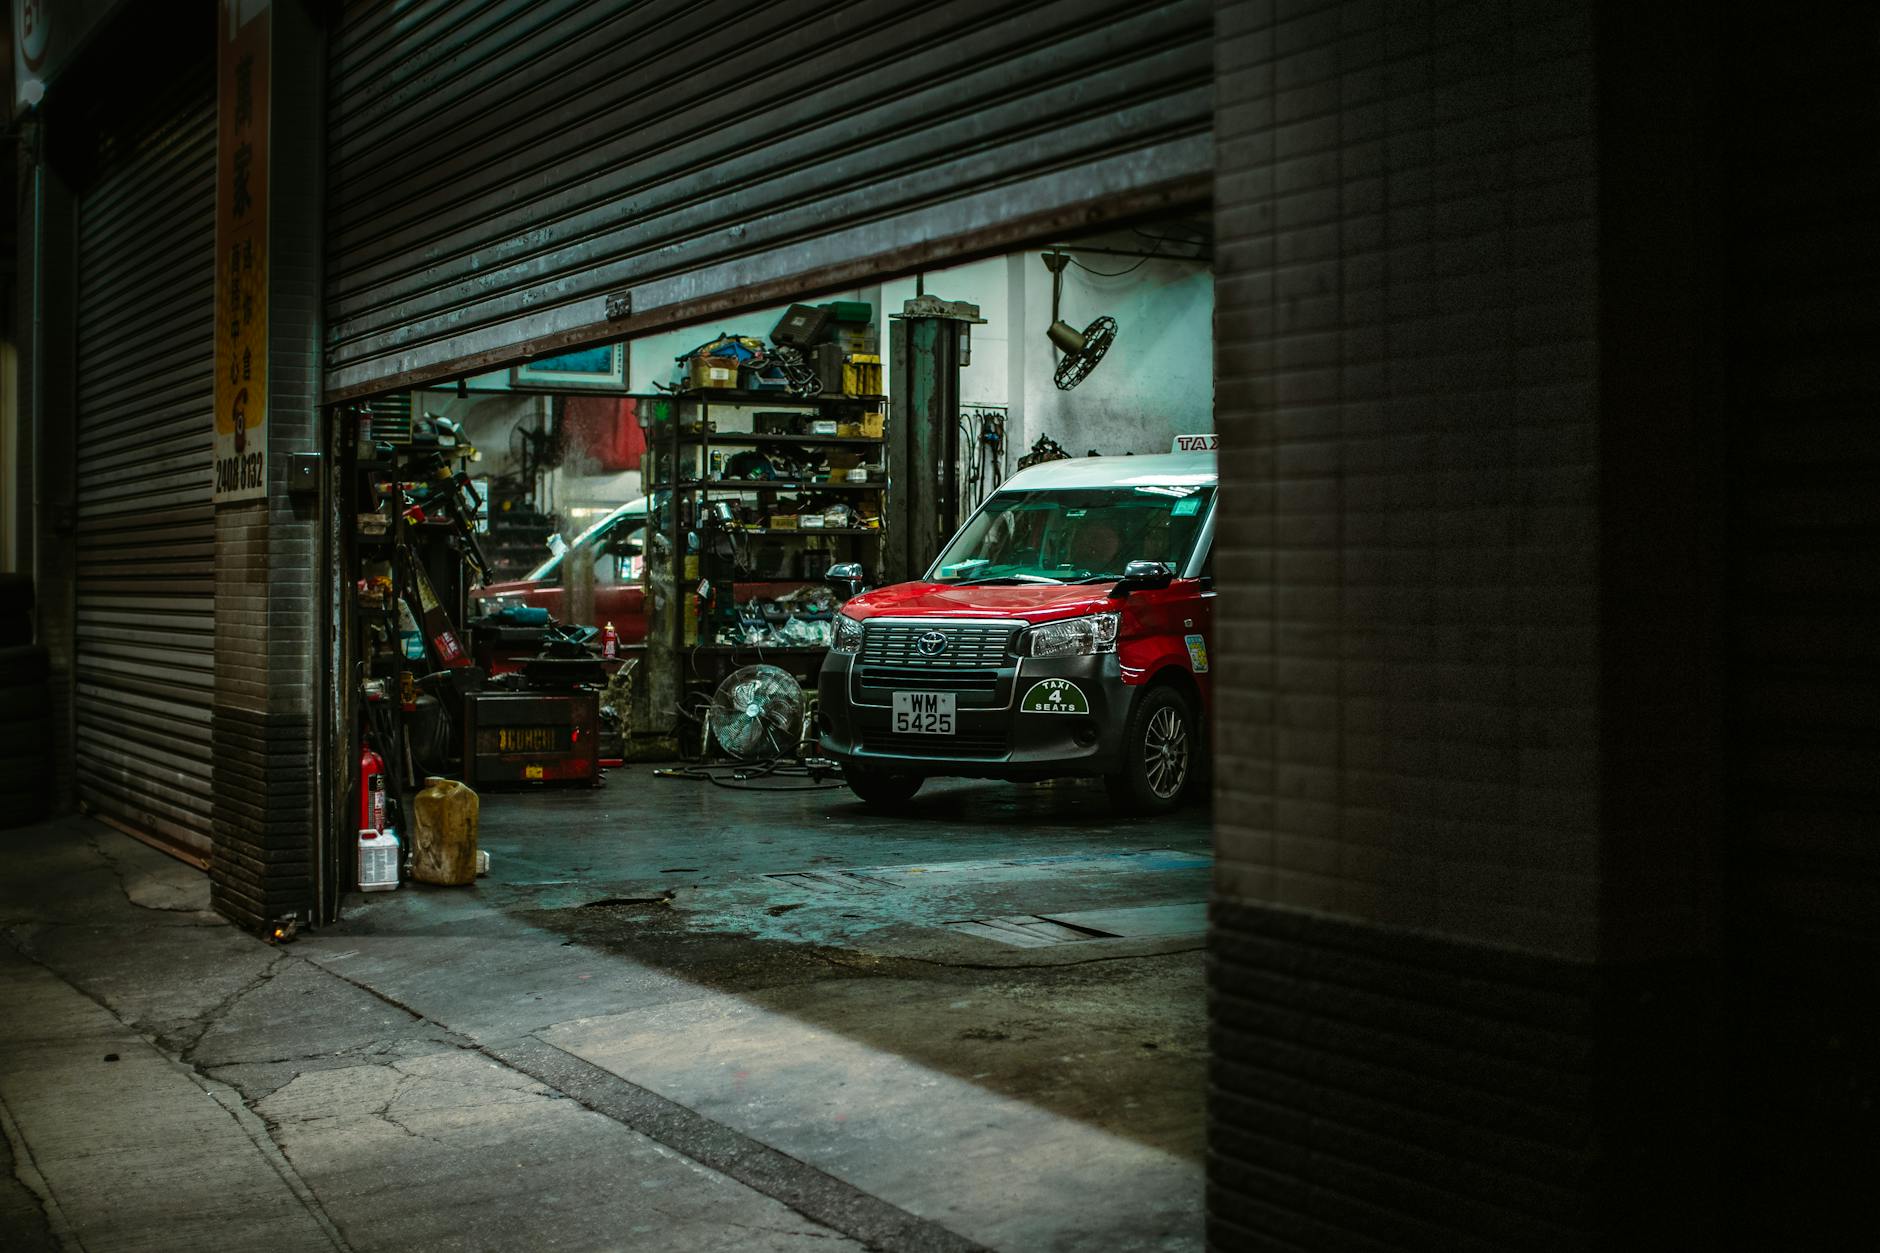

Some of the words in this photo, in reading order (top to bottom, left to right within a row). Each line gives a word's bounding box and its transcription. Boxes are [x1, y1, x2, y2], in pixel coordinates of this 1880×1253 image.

[1178, 436, 1218, 451] TAX
[216, 457, 239, 493] 2408
[240, 452, 262, 490] 8132
[1042, 680, 1070, 690] TAXI
[911, 694, 938, 713] WM
[1048, 689, 1062, 703] 4
[1035, 703, 1075, 711] SEATS
[897, 712, 951, 733] 5425
